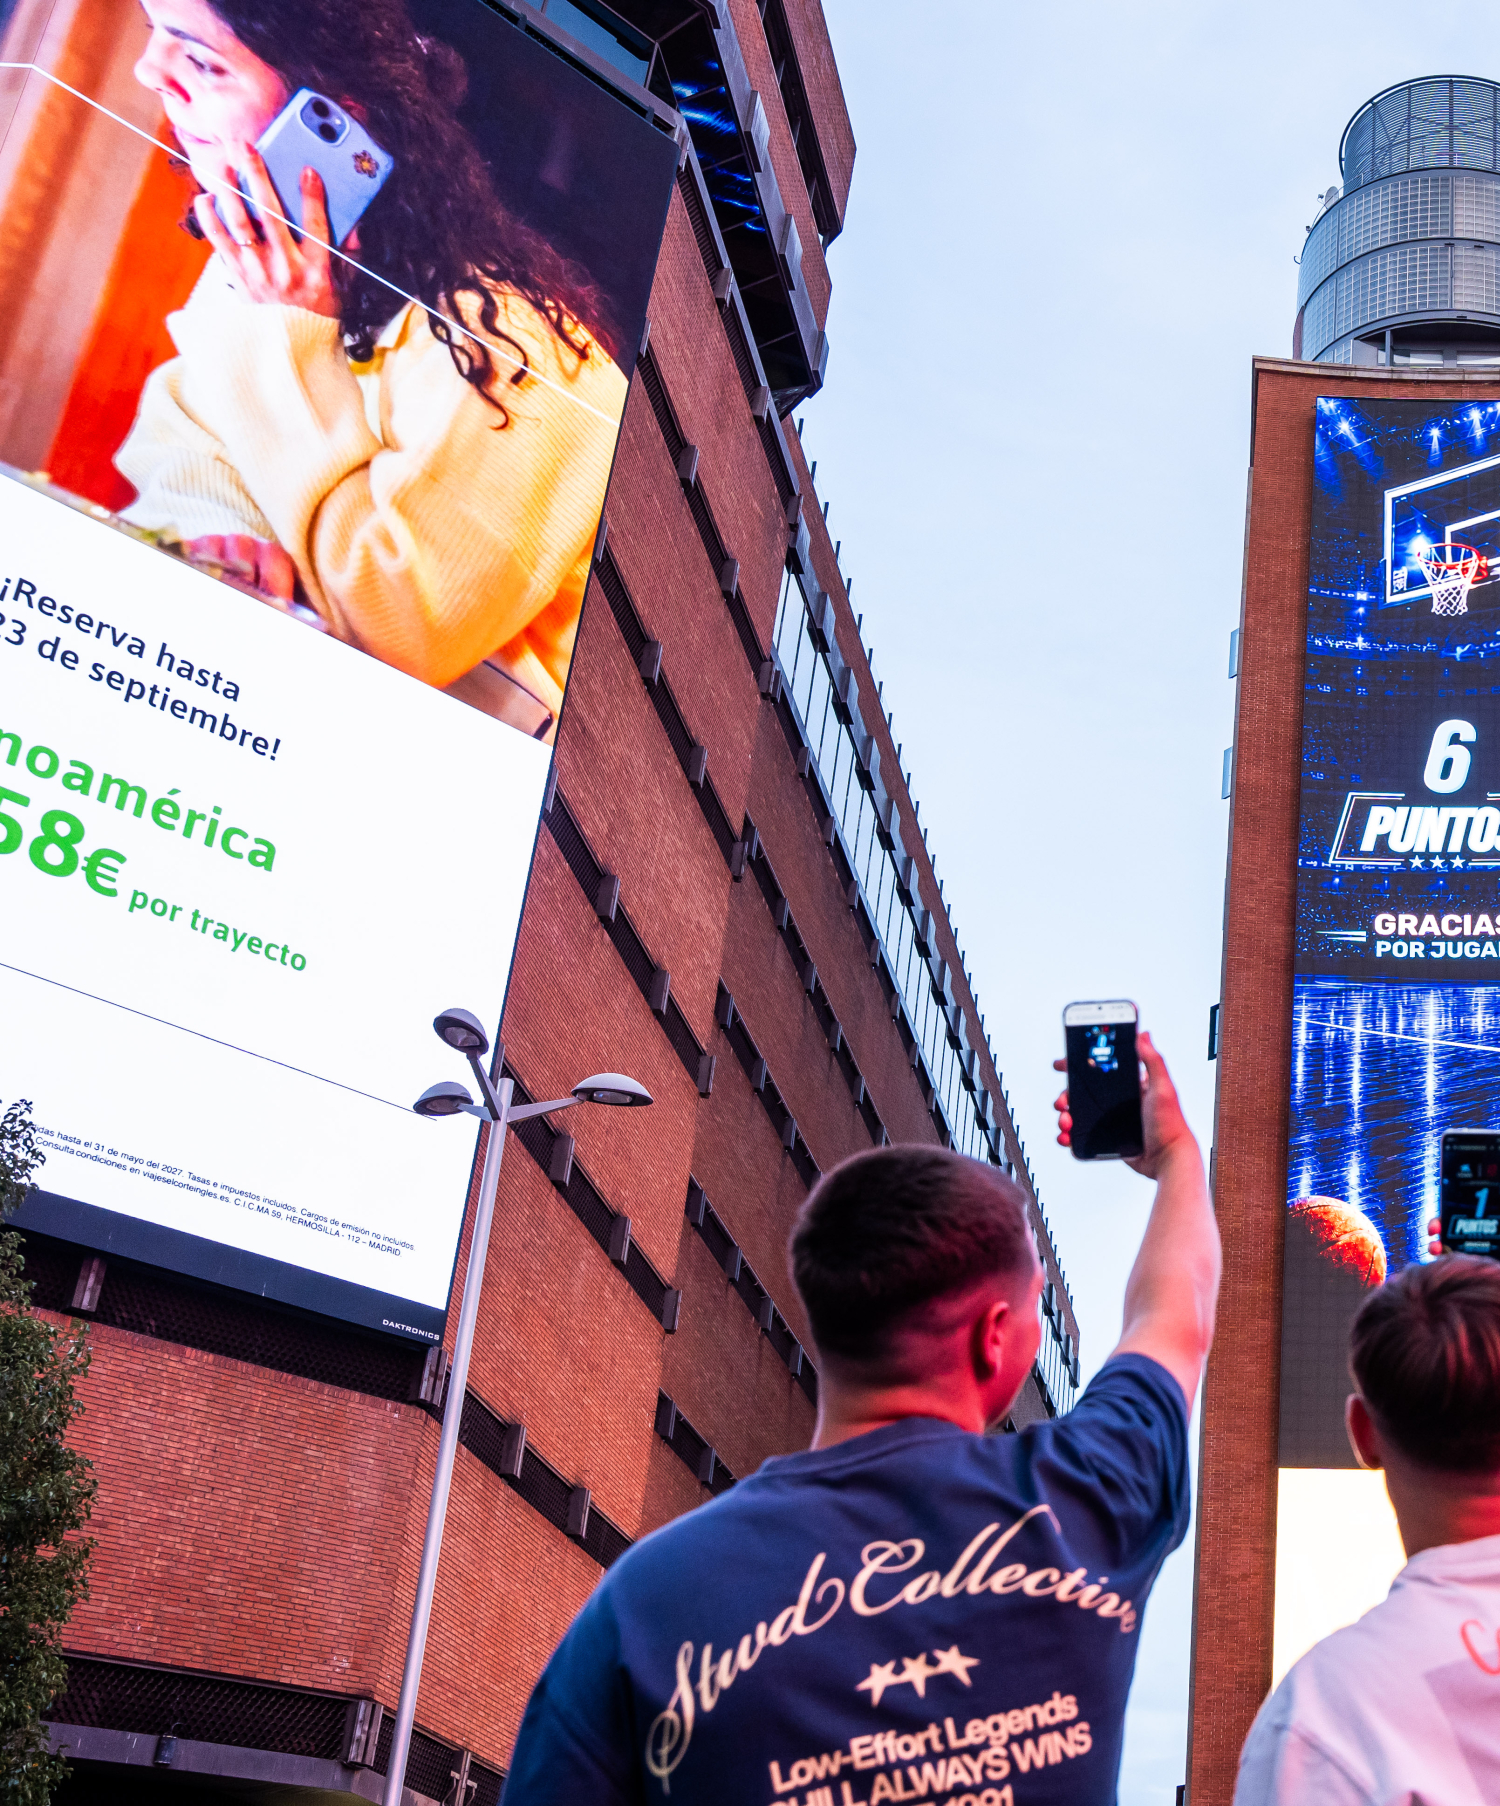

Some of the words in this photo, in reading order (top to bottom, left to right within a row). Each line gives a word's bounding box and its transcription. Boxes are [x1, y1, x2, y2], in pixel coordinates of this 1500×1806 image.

[0, 577, 146, 659] ¡Reserva
[156, 642, 241, 702] hasta
[37, 636, 80, 670] de
[88, 662, 282, 762] septiembre!
[1423, 718, 1478, 794] 6
[128, 889, 184, 922] por
[190, 908, 308, 972] trayecto
[1375, 941, 1425, 958] POR
[35, 1136, 75, 1155] Consulta
[75, 1149, 128, 1171] condiciones
[129, 1165, 141, 1175] en
[285, 1213, 340, 1238] HERMOSILLA
[347, 1233, 361, 1244] 112
[57, 1131, 82, 1146] hasta
[84, 1140, 93, 1149] el
[94, 1143, 105, 1152] 31
[107, 1147, 119, 1157] de
[121, 1152, 145, 1165] mayo
[146, 1159, 160, 1170] del
[161, 1164, 185, 1178] 2027.
[188, 1171, 211, 1187] Tasas
[212, 1181, 219, 1189] e
[220, 1182, 261, 1202] impuestos
[262, 1195, 298, 1214] incluidos.
[300, 1208, 329, 1224] Cargos
[330, 1217, 340, 1227] de
[341, 1221, 370, 1236] emisión
[371, 1230, 382, 1240] no
[382, 1318, 440, 1341] DAKTRONICS
[850, 1503, 1137, 1634] Collective
[769, 1721, 945, 1795] Low-Effort
[943, 1691, 1079, 1749] Legends
[870, 1744, 1011, 1806] ALWAYS
[1010, 1721, 1093, 1774] WINS
